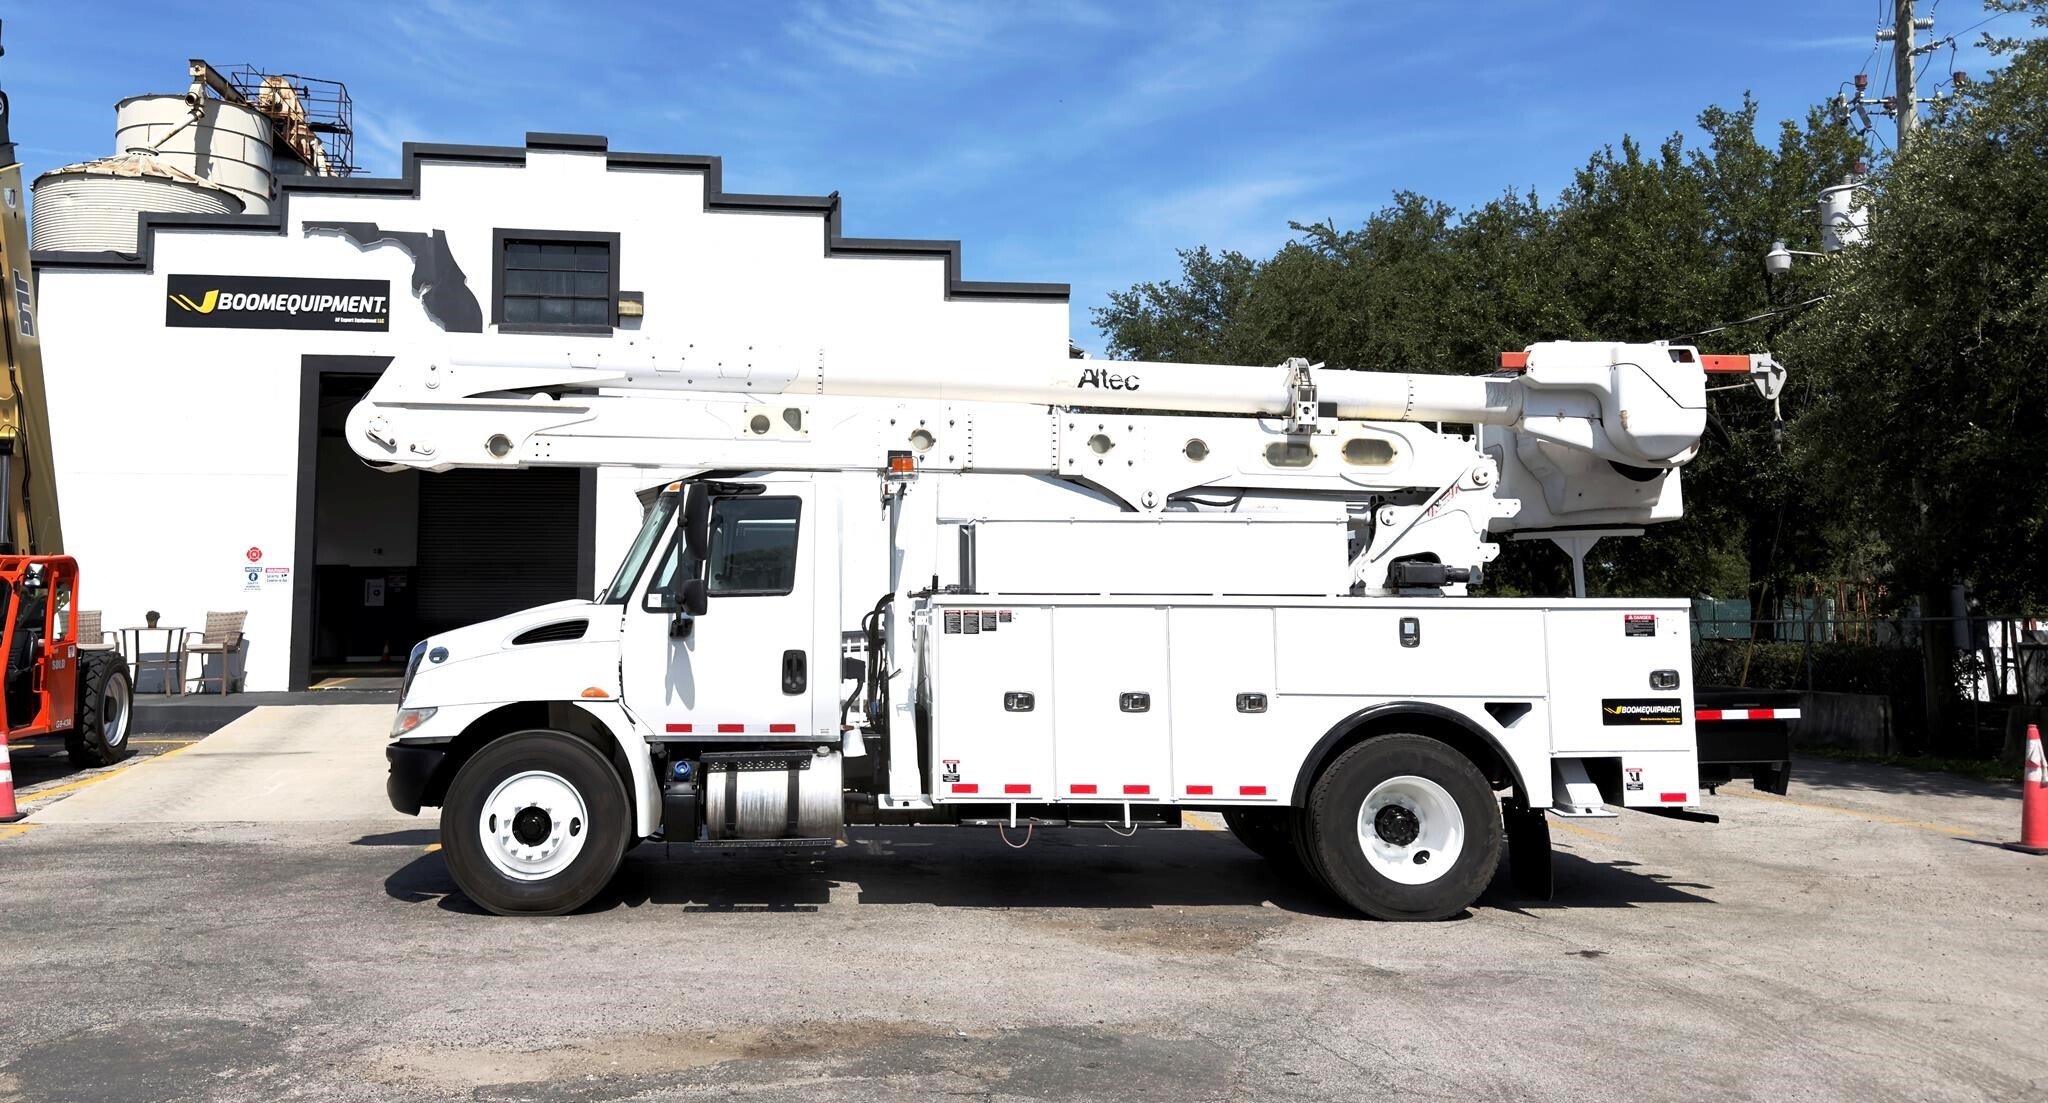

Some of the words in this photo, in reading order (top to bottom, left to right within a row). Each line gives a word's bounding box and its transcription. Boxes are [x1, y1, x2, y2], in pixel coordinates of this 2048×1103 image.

[13, 268, 35, 337] JLG
[218, 292, 387, 316] BOOMEQUIPMENT.
[1077, 368, 1140, 391] Altec
[51, 658, 66, 671] SOLD
